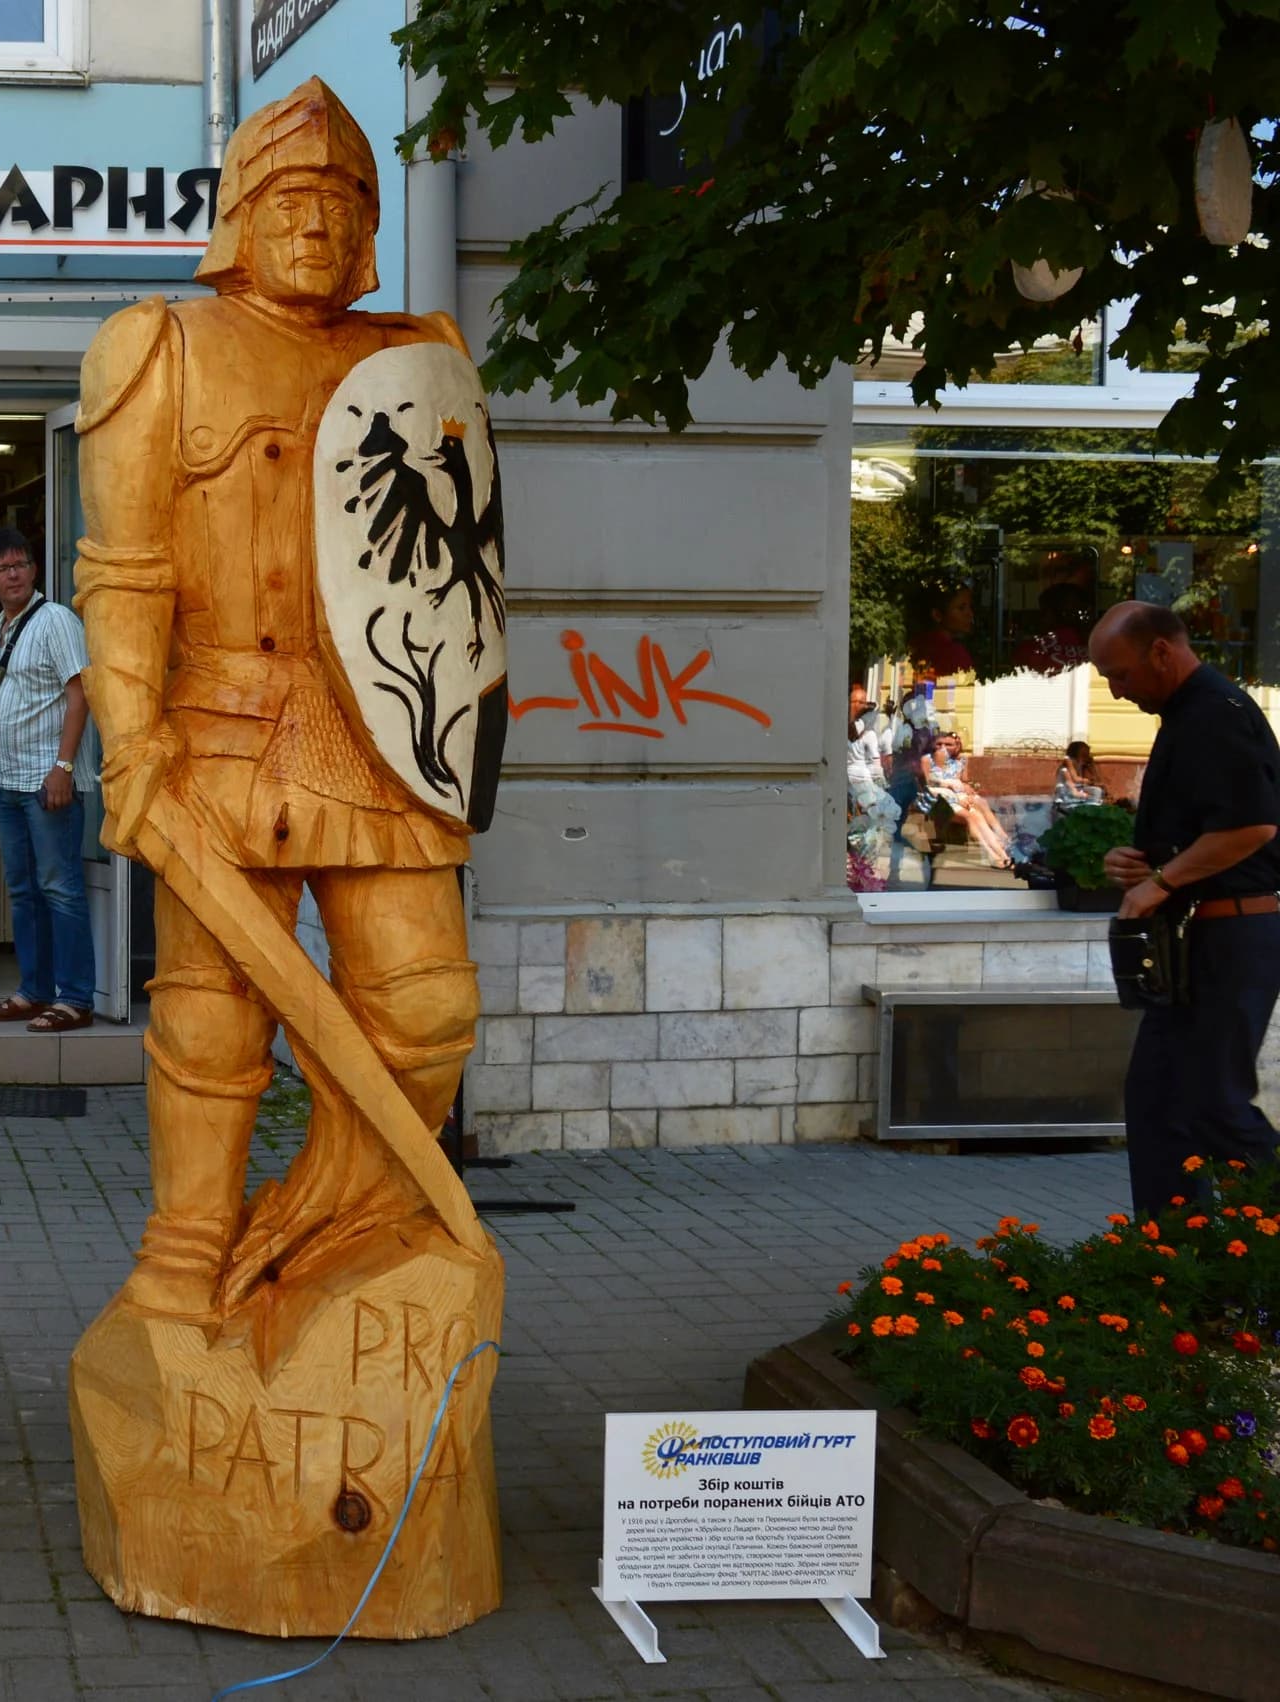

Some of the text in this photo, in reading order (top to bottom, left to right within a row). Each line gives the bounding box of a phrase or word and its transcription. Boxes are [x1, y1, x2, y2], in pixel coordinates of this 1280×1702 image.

[257, 0, 295, 63] НАДІЯ
[350, 1299, 477, 1391] PRO
[184, 1389, 467, 1518] PATRIA
[812, 1435, 856, 1449] ГУРТ
[618, 1494, 865, 1513] на потреби поранених бійців АТО
[698, 1478, 784, 1493] Збір коштів
